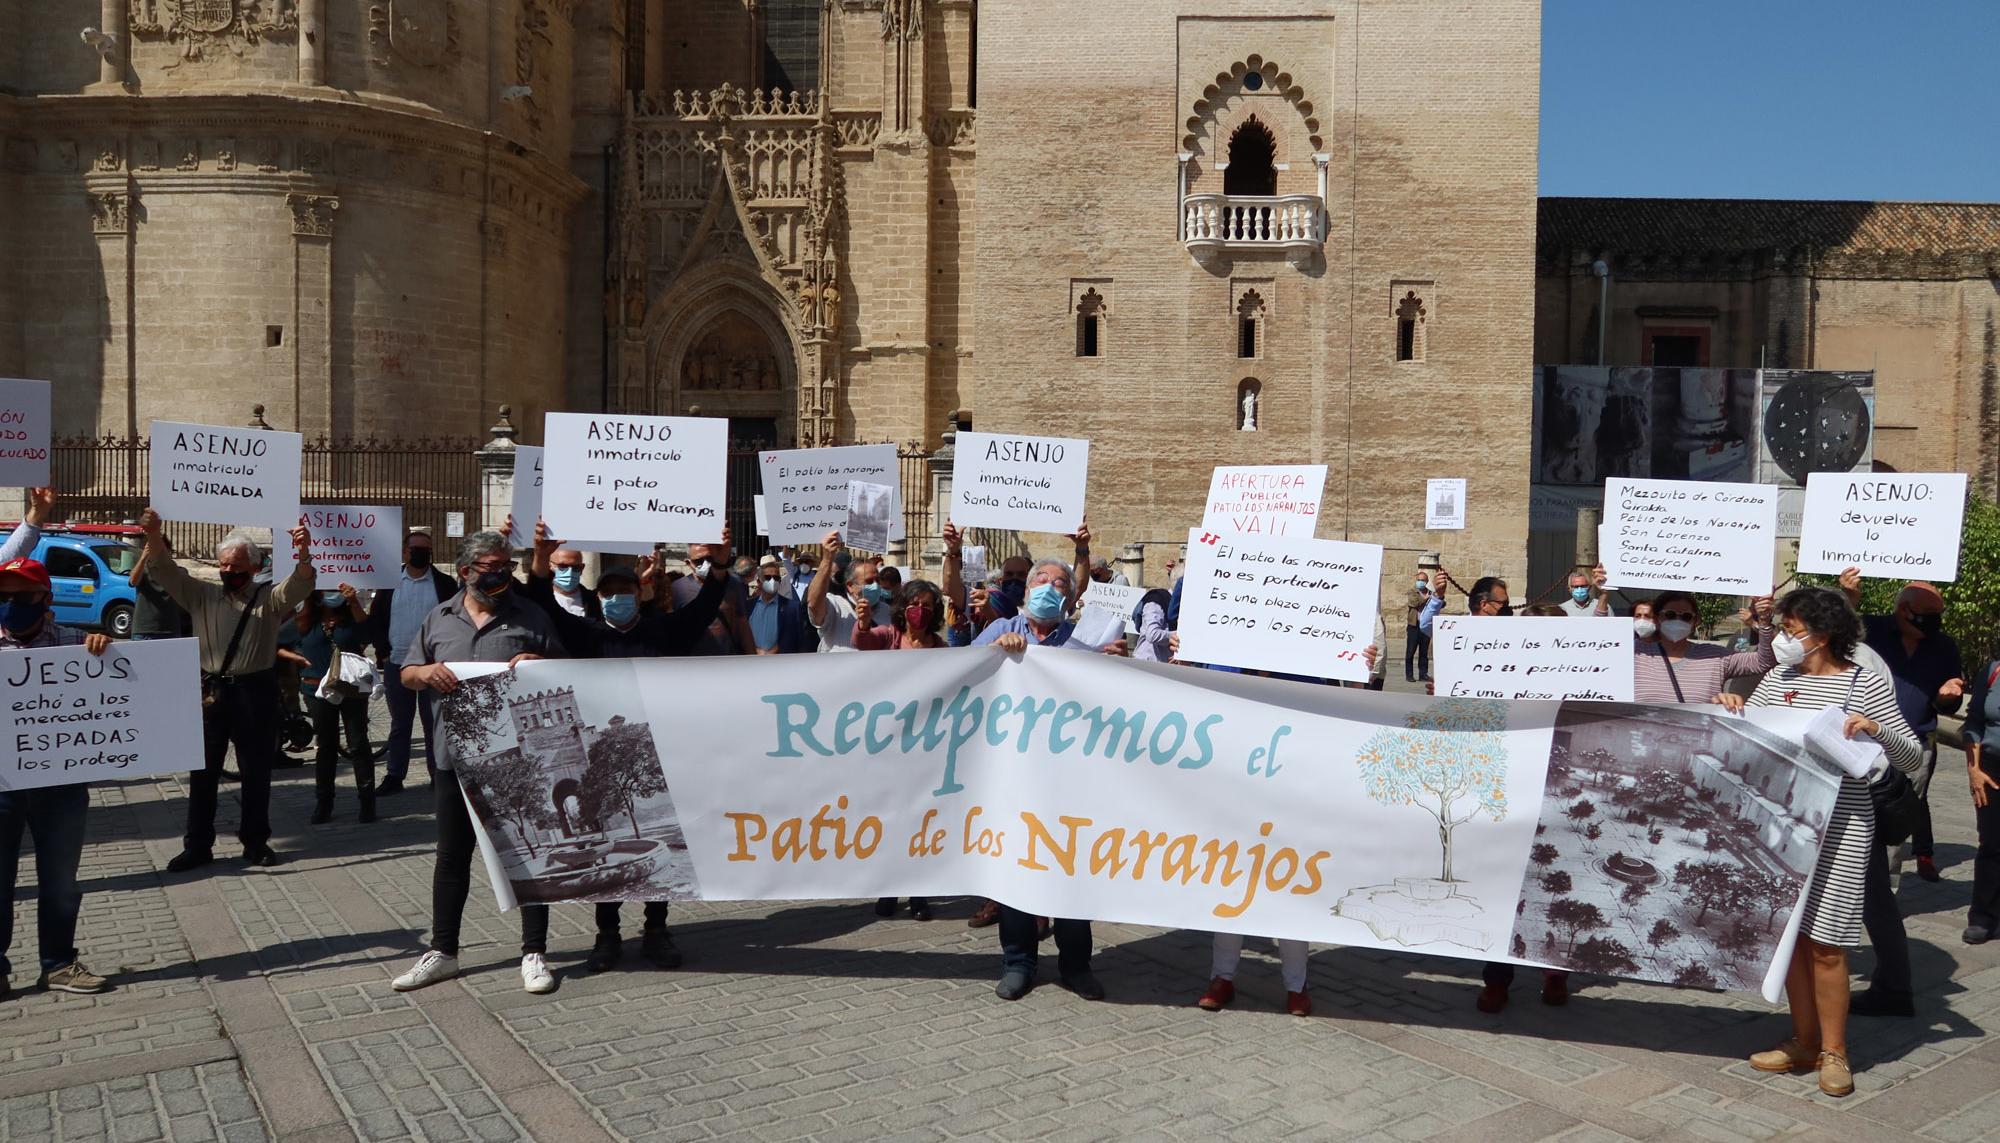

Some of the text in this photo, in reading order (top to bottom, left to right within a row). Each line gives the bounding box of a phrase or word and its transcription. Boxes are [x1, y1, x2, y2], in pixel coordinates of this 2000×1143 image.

[0, 408, 25, 424] ÓN
[0, 430, 27, 441] DO
[588, 420, 671, 441] ASENJO
[173, 432, 267, 456] ASENJO
[985, 440, 1065, 463] ASENJO
[779, 468, 789, 478] El
[795, 466, 823, 477] patio
[843, 465, 885, 475] naranjos
[979, 470, 1052, 489] inmatriculó
[171, 480, 264, 499] LA GIRALDA
[586, 475, 658, 491] El patio
[781, 485, 796, 493] no
[1221, 472, 1305, 490] APERTURA
[1241, 491, 1288, 501] PUBLICA
[1692, 492, 1708, 501] de
[1846, 482, 1933, 502] ASENJO:
[586, 496, 715, 517] de los Naranjos
[782, 502, 848, 514] Es una plaz
[963, 490, 1063, 514] Santa Catalina
[1213, 502, 1316, 515] PATIO LOS NARANJOS
[1621, 499, 1668, 512] Giralda
[302, 511, 376, 529] ASENJO
[786, 521, 815, 530] como
[1620, 513, 1761, 530] Patio de los Naranjos
[1840, 510, 1918, 526] devuelve
[1620, 525, 1710, 541] San Lorenzo
[1866, 528, 1880, 541] lo
[292, 535, 365, 549] pvatizó
[1618, 540, 1721, 557] Santa Catalina
[1217, 545, 1234, 559] El
[1241, 551, 1275, 564] patio
[1306, 559, 1364, 574] naranjos
[1619, 552, 1690, 568] Catedral
[320, 564, 375, 573] SEVILLA
[1213, 568, 1340, 590] no es particular
[1092, 585, 1129, 598] ASENJO
[1210, 587, 1351, 618] Es una plaza pública
[1299, 624, 1355, 643] demás
[1452, 636, 1621, 653] El patio los Naranjos
[1472, 663, 1609, 675] no es particular
[1450, 681, 1470, 697] Es
[1476, 688, 1504, 698] una
[1513, 689, 1553, 700] plaza
[12, 692, 131, 712] echó a los
[15, 709, 131, 726] mercaderes
[16, 728, 140, 752] ESPADAS
[761, 685, 1292, 797] Recuperemos el
[18, 751, 139, 771] los protege
[724, 795, 1332, 918] Patio de los Naranjos
